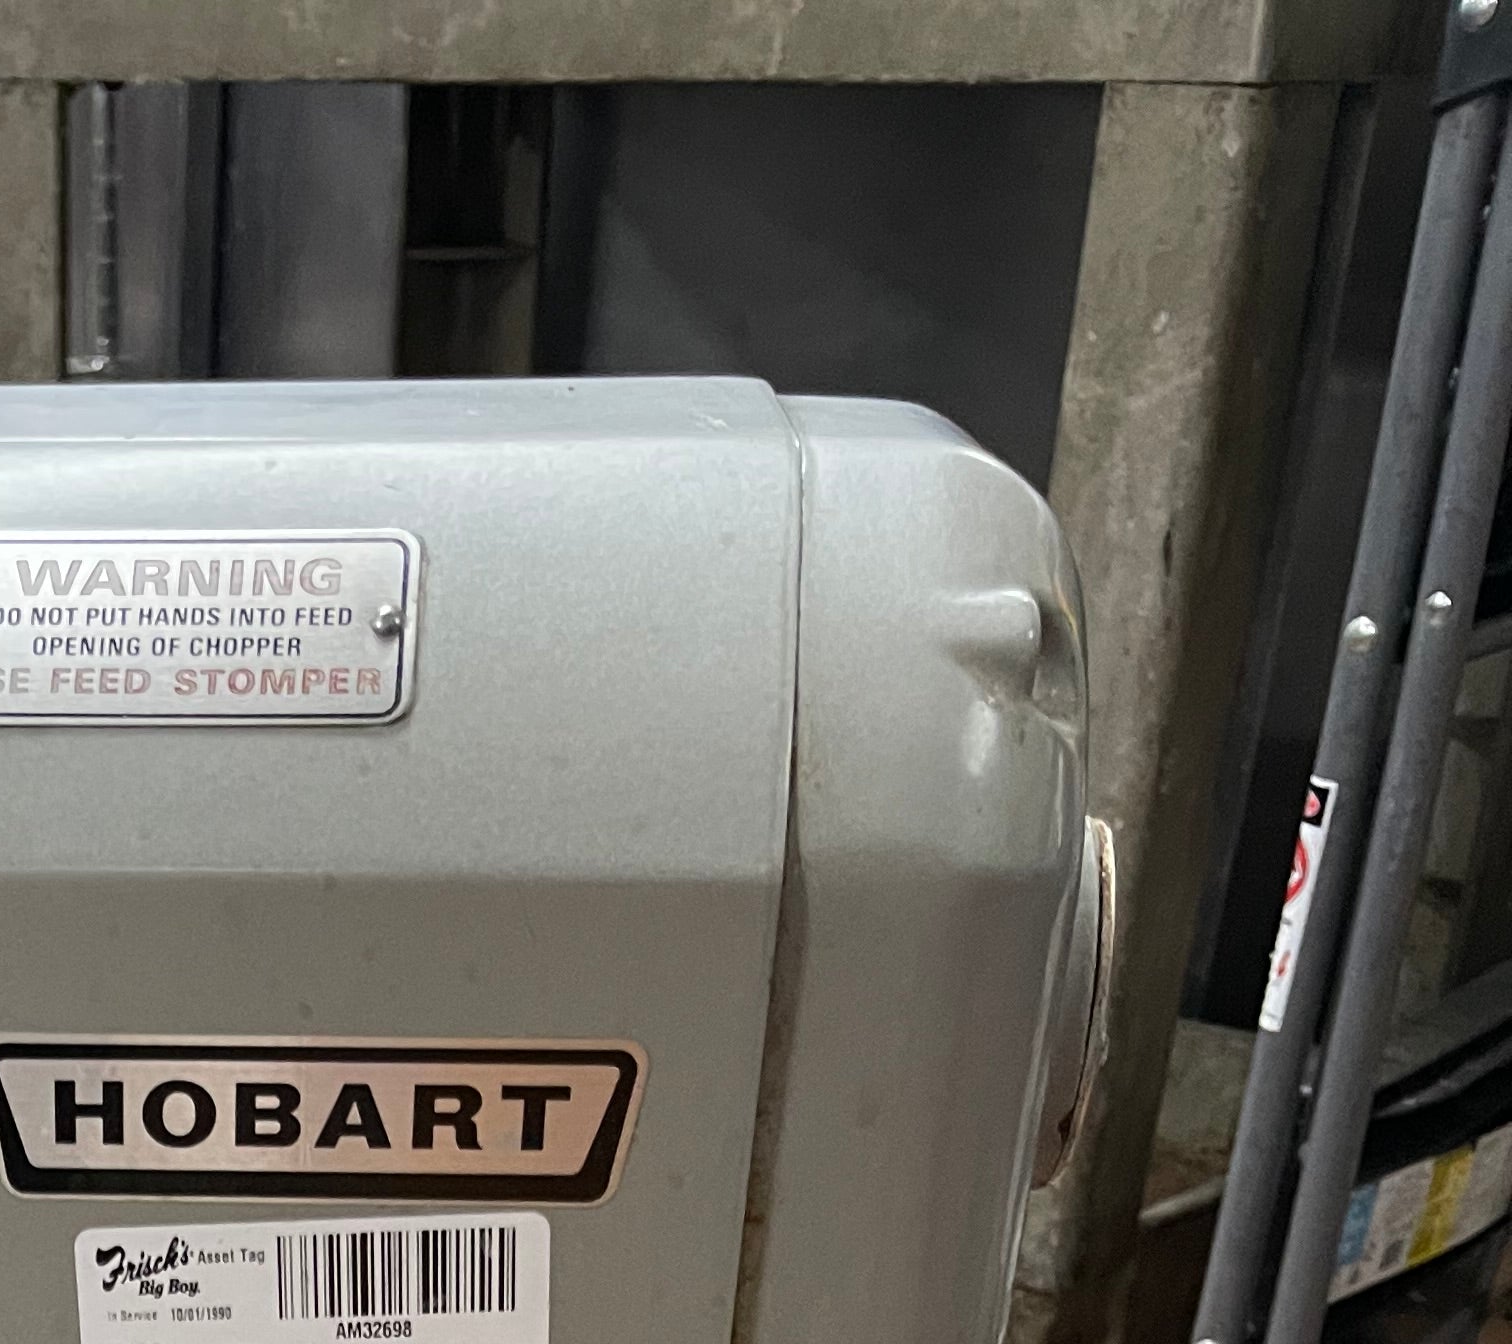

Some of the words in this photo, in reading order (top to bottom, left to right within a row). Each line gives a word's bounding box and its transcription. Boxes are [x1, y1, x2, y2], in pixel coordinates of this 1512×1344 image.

[16, 559, 344, 597] WARNING
[30, 607, 78, 626] NOT
[87, 607, 128, 626] PUT
[138, 607, 220, 626] HANDS
[230, 607, 286, 626] INTO
[294, 607, 353, 626] FEED
[32, 637, 140, 657] OPENING
[151, 637, 181, 656] OF
[189, 637, 302, 657] CHOPPER
[50, 668, 151, 695] FEED
[174, 668, 382, 696] STOMPER
[53, 1080, 572, 1151] HOBART
[96, 1235, 190, 1292] Frisch's
[197, 1250, 235, 1265] Asset
[240, 1249, 265, 1264] Tag
[138, 1279, 165, 1299] Big
[171, 1306, 232, 1322] 10/01/1990
[336, 1320, 412, 1339] AM32698
